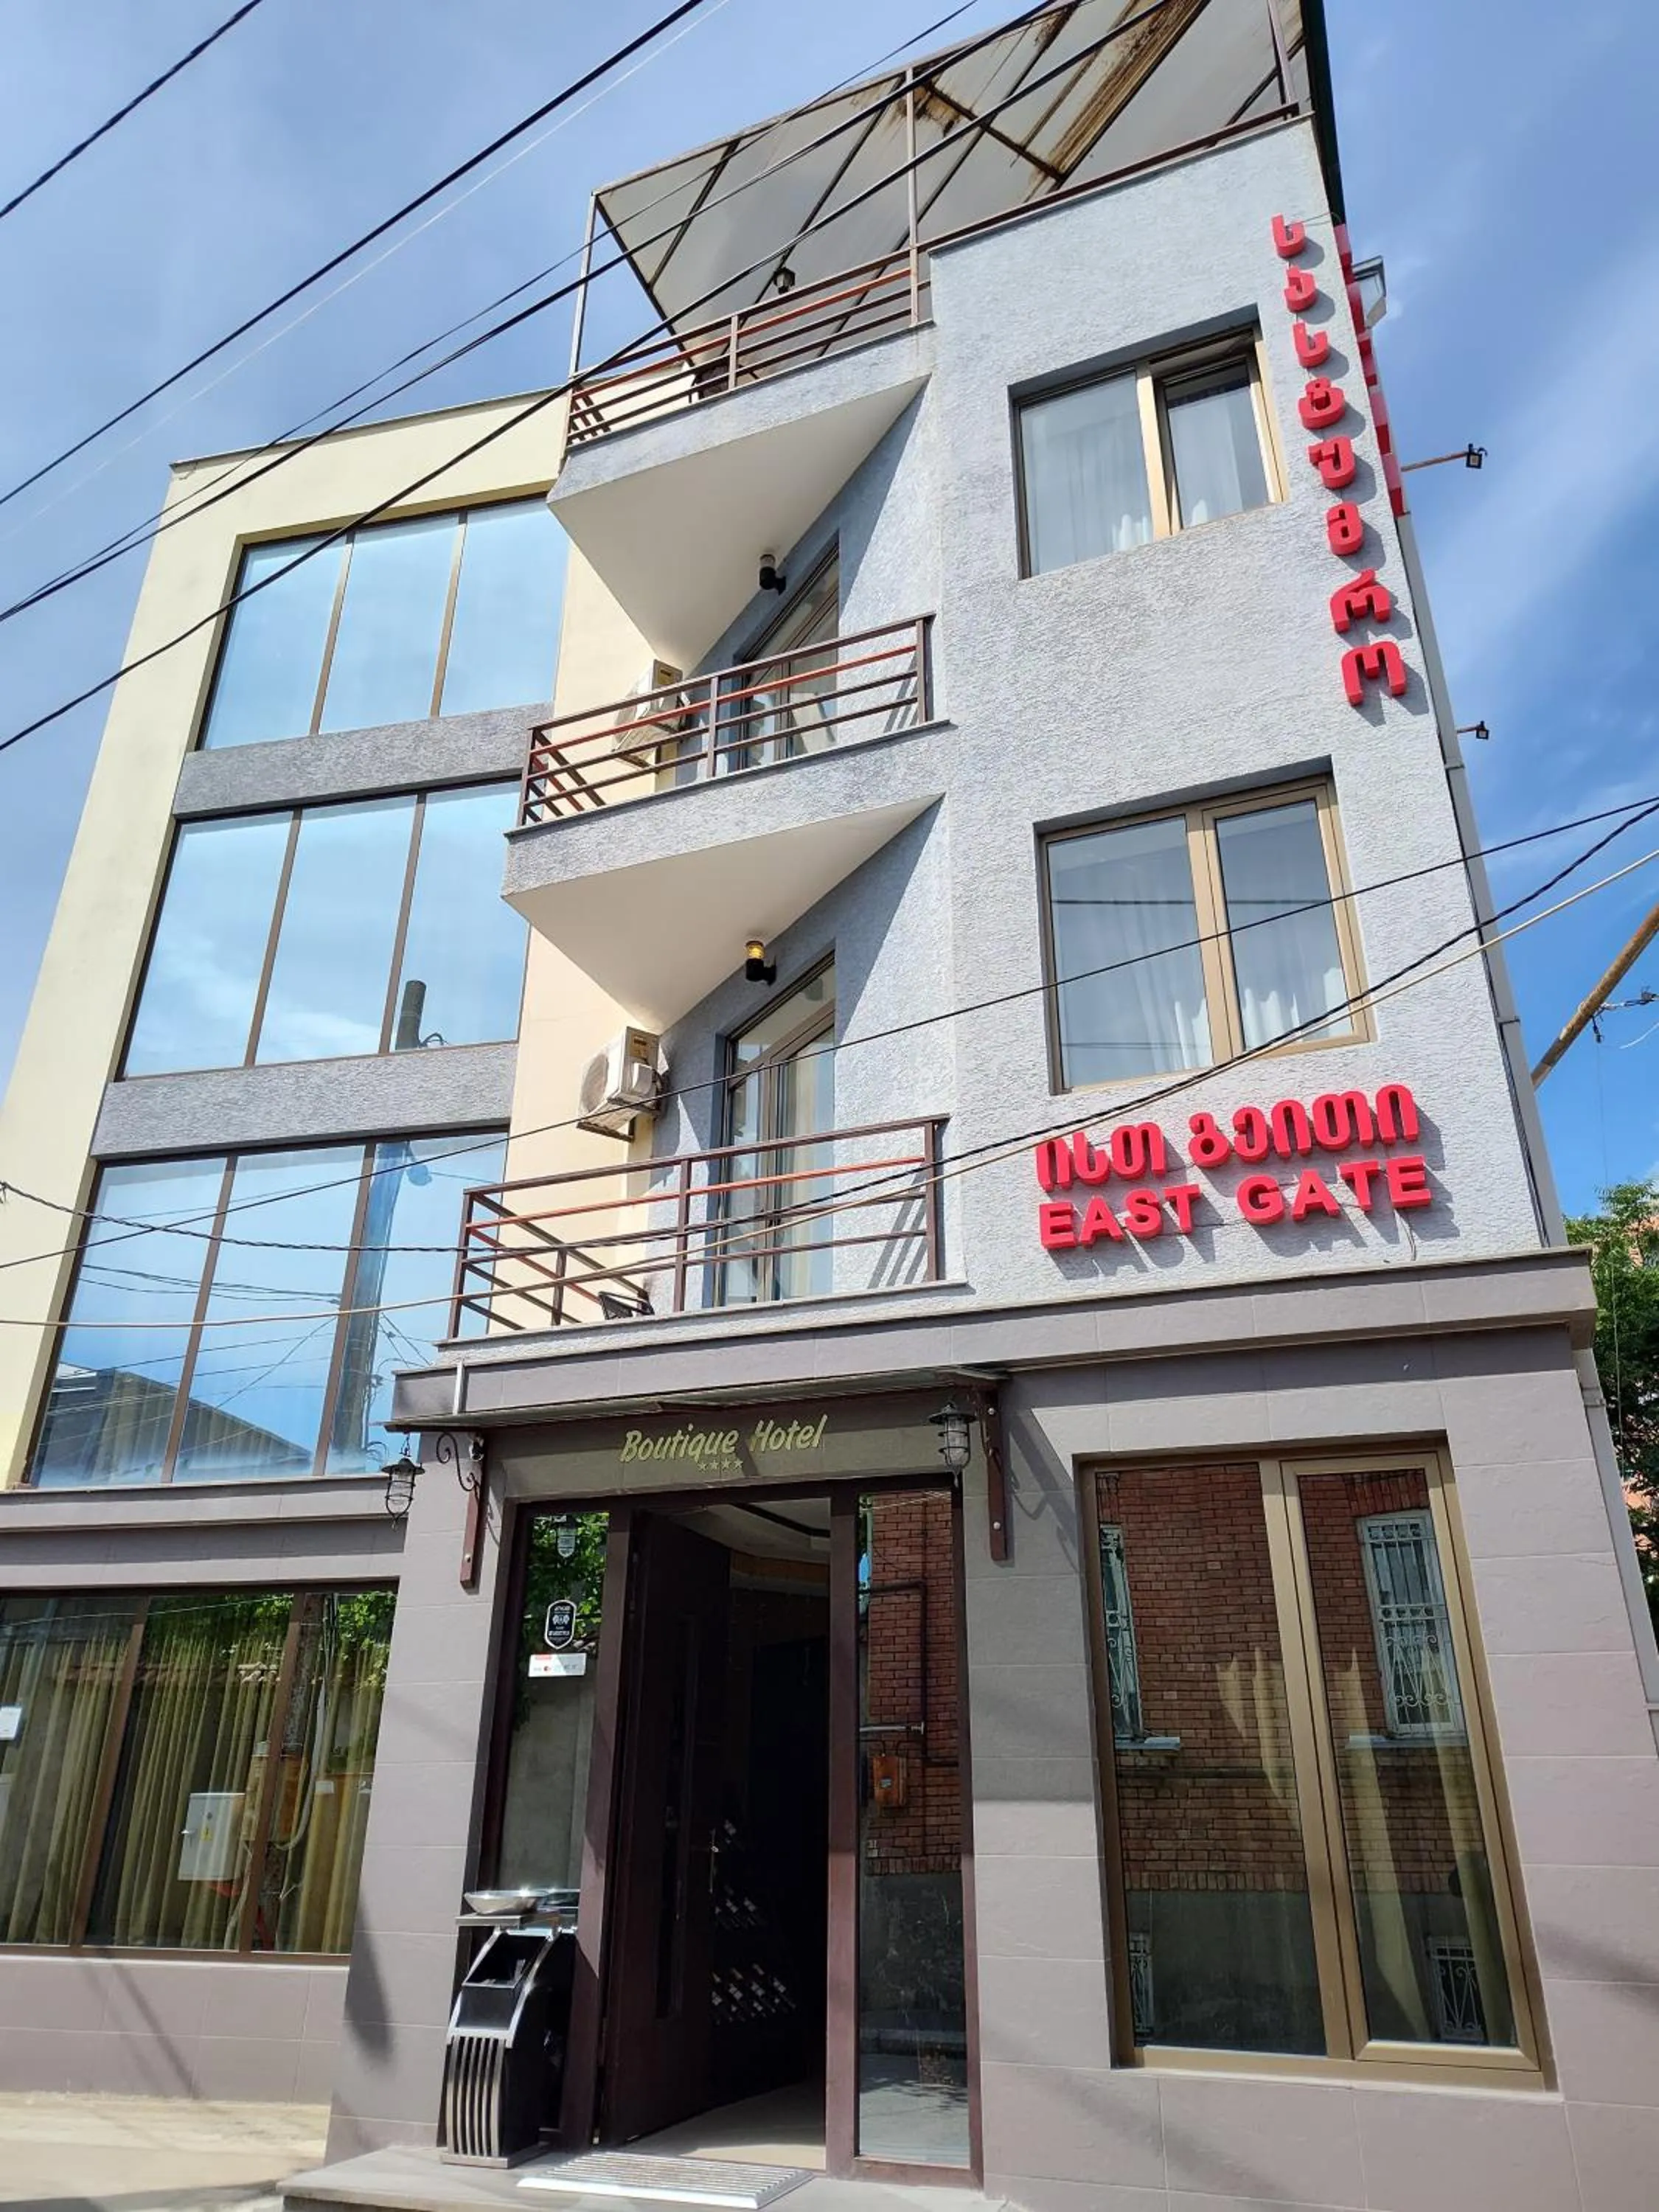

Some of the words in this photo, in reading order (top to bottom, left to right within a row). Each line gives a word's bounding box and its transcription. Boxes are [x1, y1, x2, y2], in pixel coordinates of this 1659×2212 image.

[1270, 212, 1407, 707] სასტუმრო
[1034, 1121, 1168, 1193] ისთ
[1186, 1083, 1420, 1169] გეითი
[1038, 1183, 1201, 1250] EAST
[1234, 1155, 1433, 1225] GATE
[619, 1422, 739, 1463] Boutique
[748, 1413, 828, 1452] Hotel
